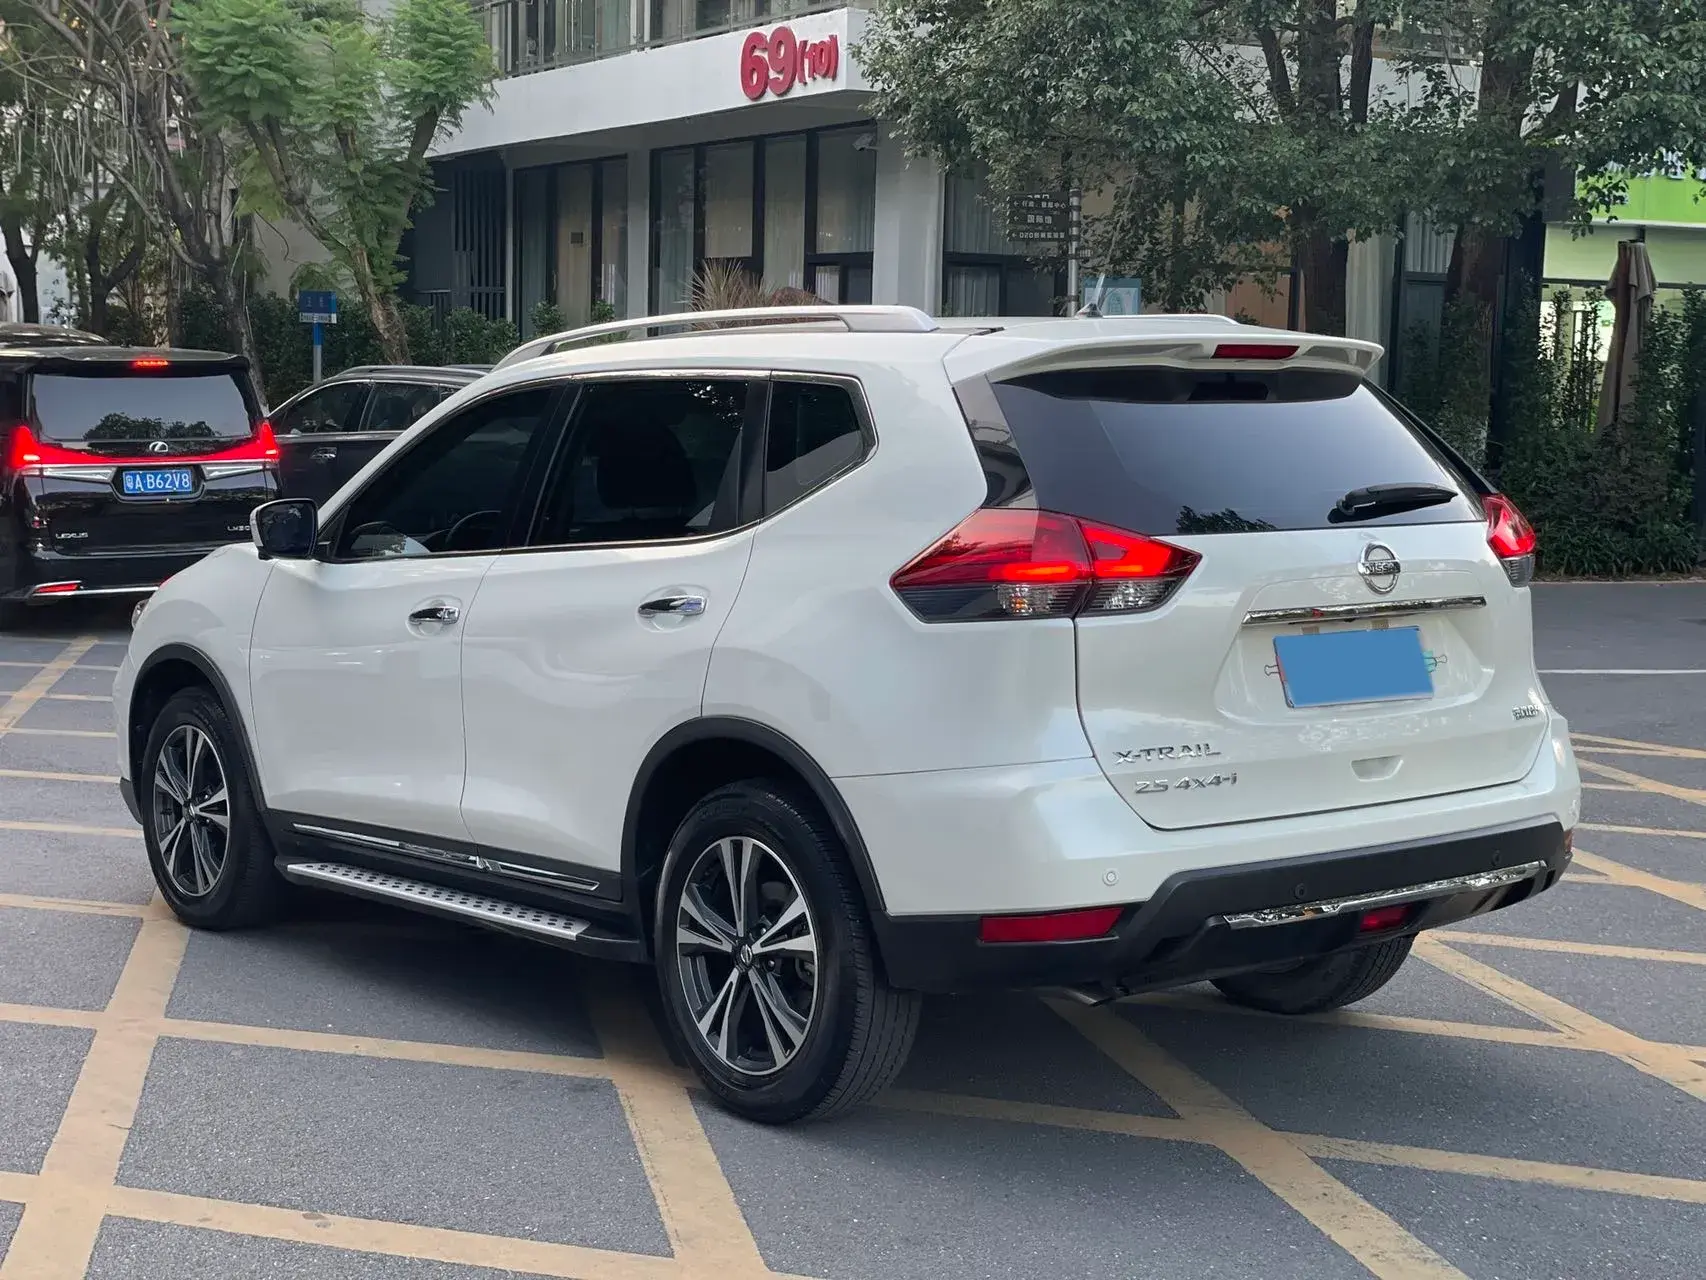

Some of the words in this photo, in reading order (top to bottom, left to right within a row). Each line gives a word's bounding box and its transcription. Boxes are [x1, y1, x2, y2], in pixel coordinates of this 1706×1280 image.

[55, 530, 89, 540] LEXUS
[1364, 562, 1399, 575] NISSA
[1113, 743, 1222, 765] X-TRAIL
